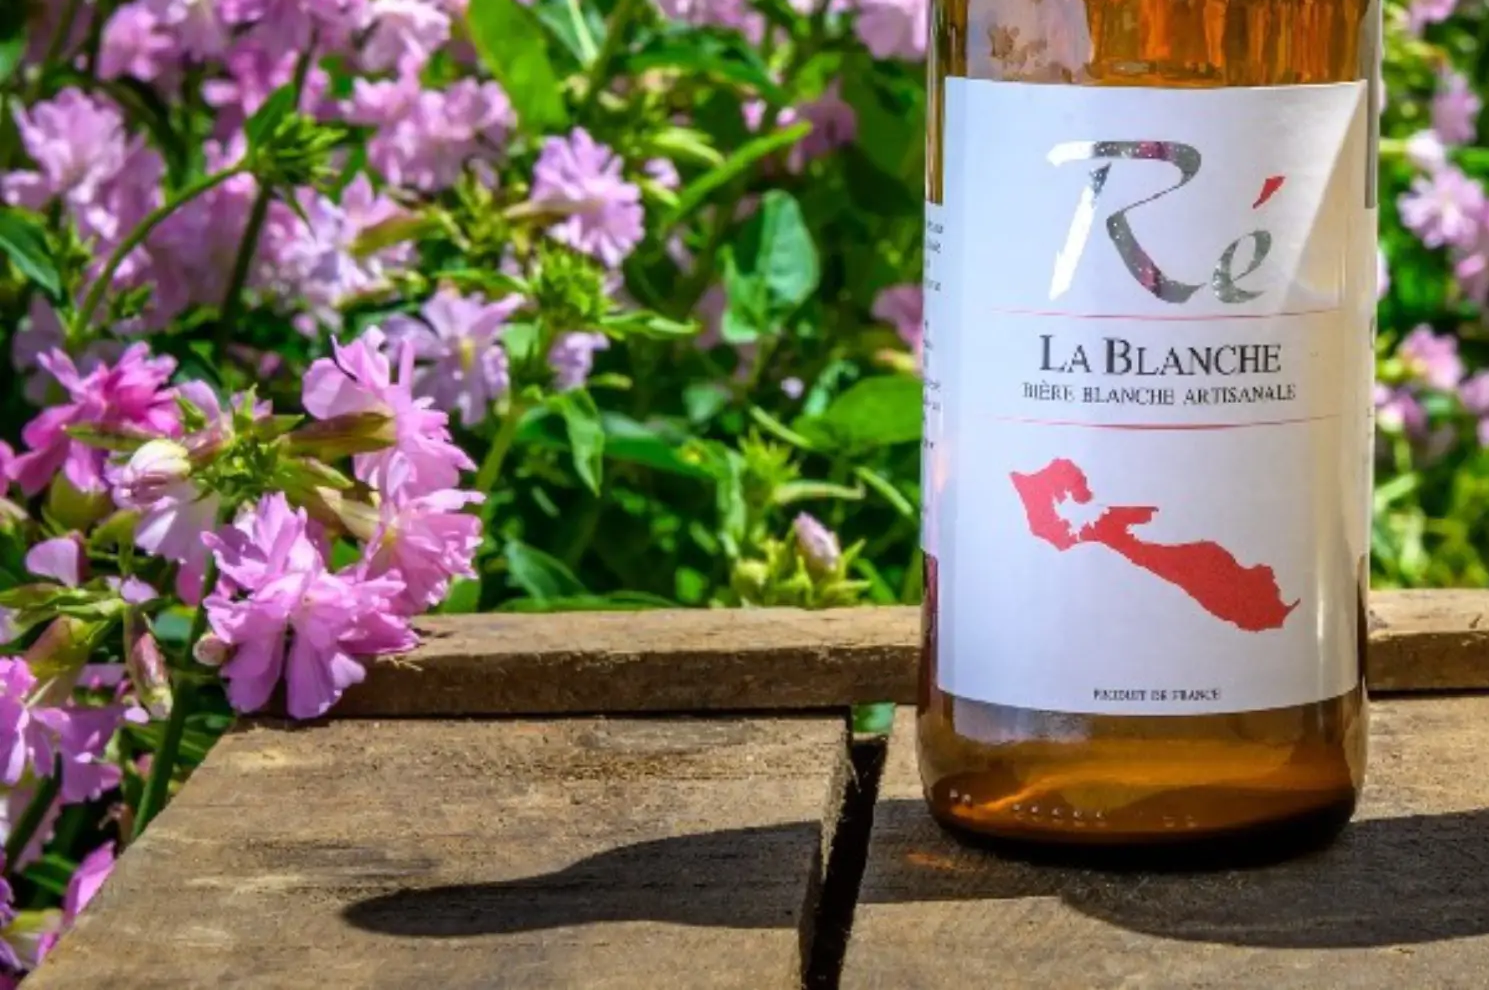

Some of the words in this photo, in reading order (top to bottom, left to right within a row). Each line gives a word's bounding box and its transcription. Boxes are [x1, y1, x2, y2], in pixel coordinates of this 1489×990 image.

[1046, 140, 1286, 304] Ré
[1082, 386, 1174, 406] BLANCHE
[1182, 384, 1297, 406] ARTISANALE
[1171, 689, 1220, 701] FRANCE
